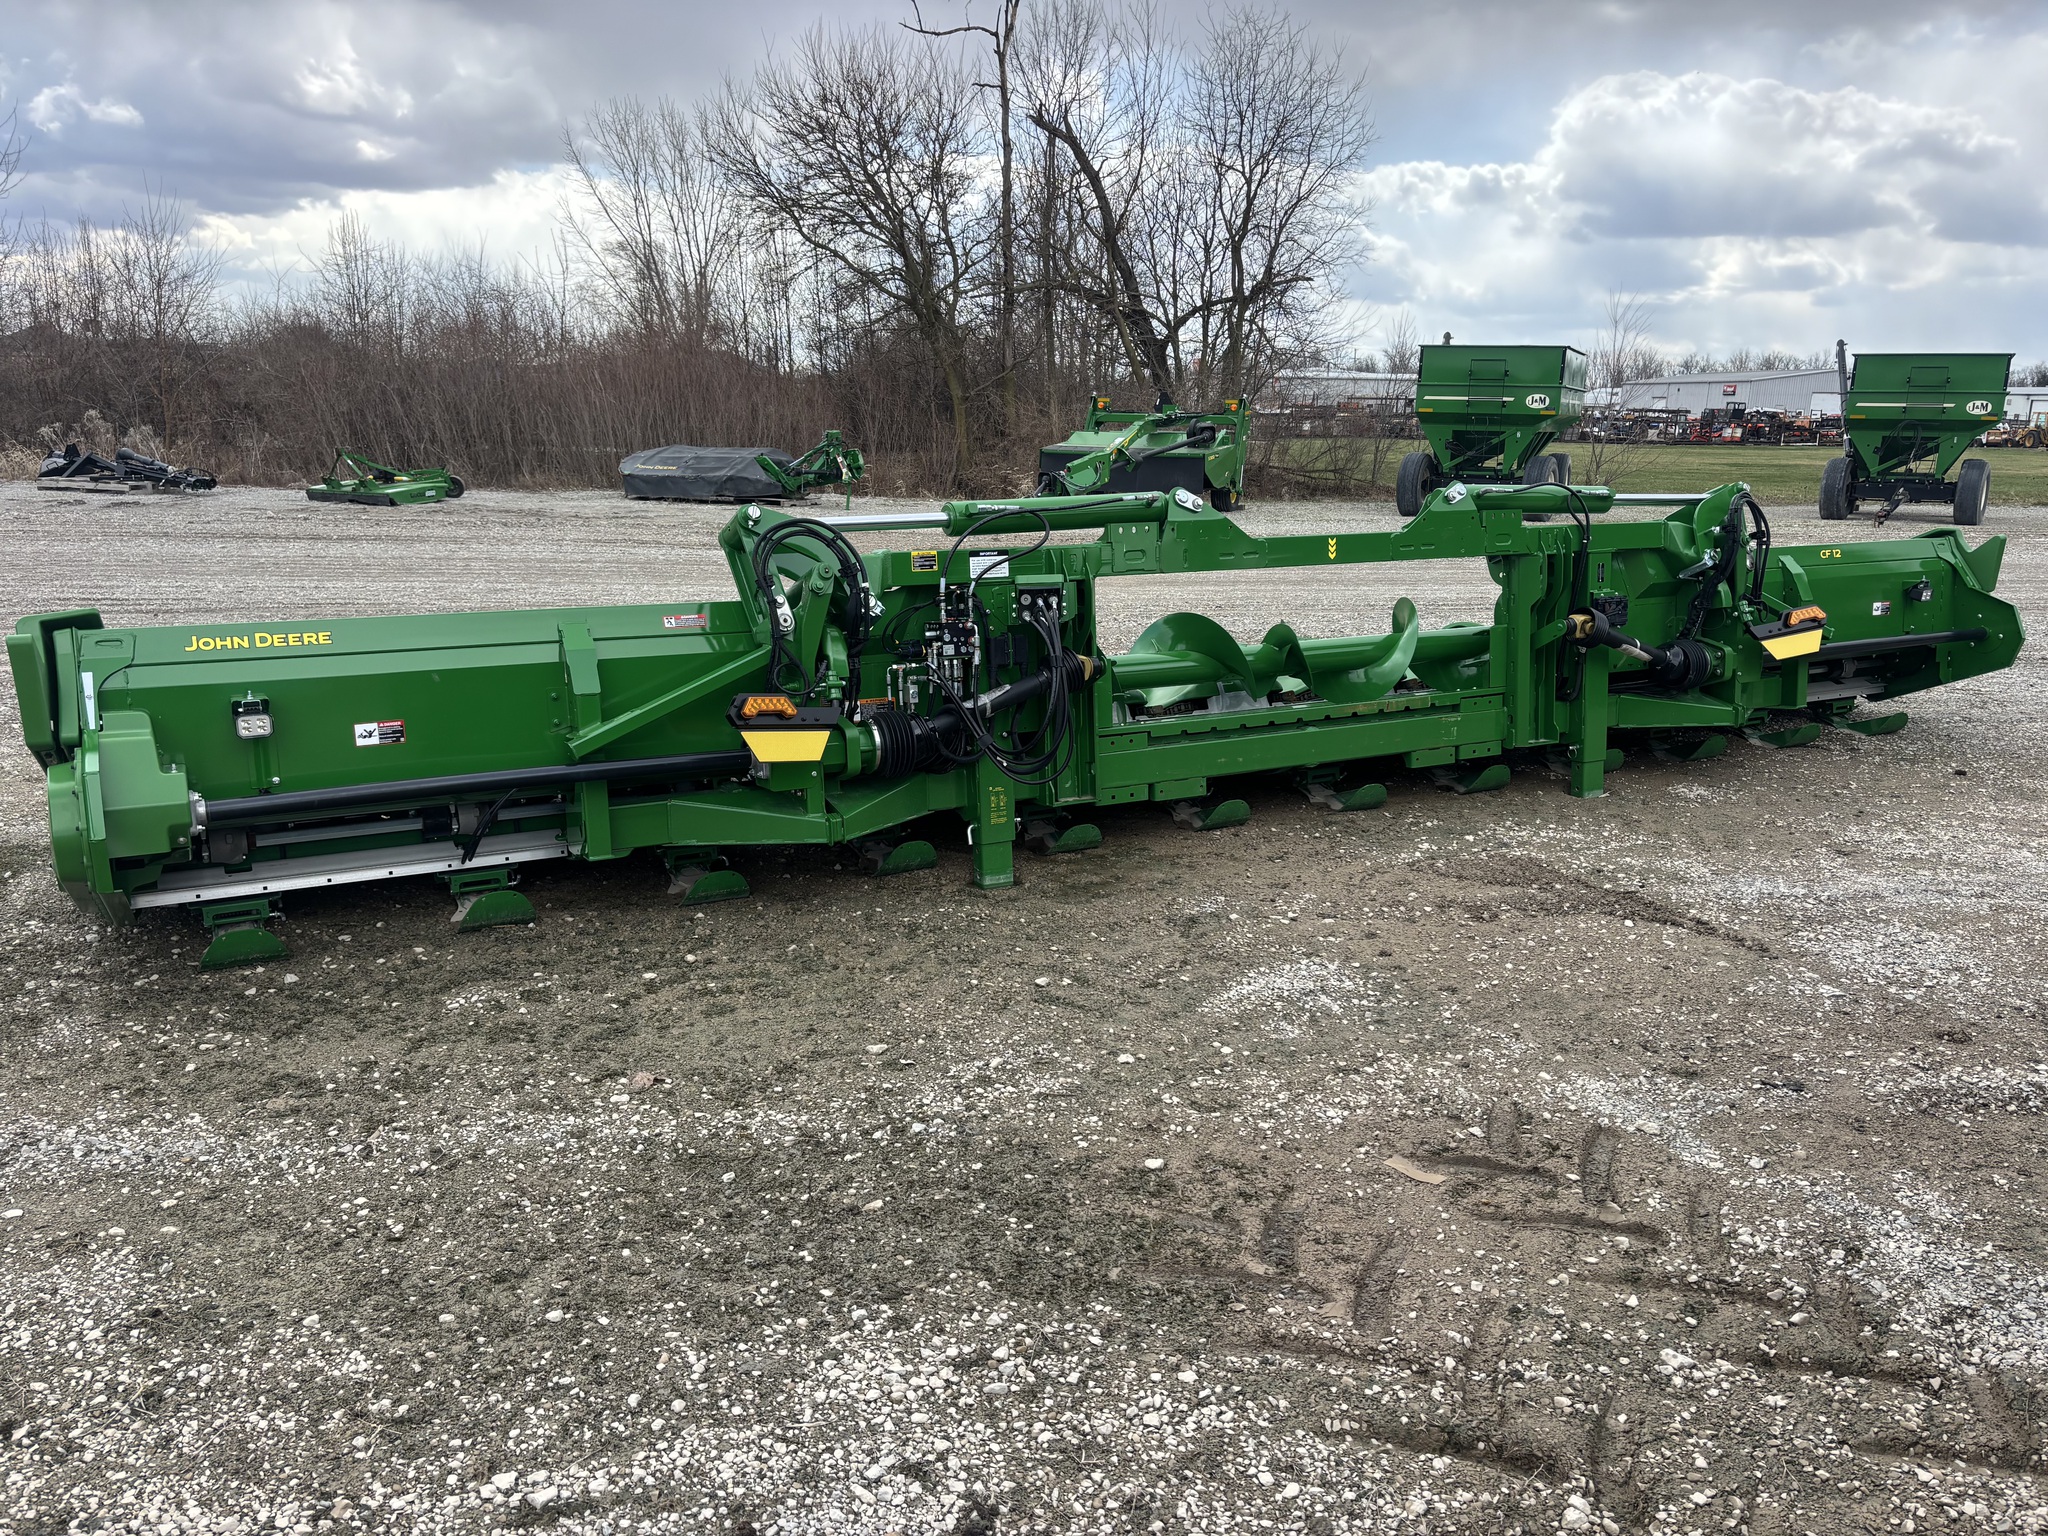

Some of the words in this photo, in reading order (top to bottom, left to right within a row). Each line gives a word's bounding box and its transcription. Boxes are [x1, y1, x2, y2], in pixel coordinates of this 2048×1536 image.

[1527, 395, 1547, 406] J&M
[1968, 402, 1989, 412] J&M
[1820, 549, 1831, 559] CF
[1832, 549, 1842, 558] 12
[184, 635, 250, 652] JOHN
[254, 631, 333, 648] DEERE
